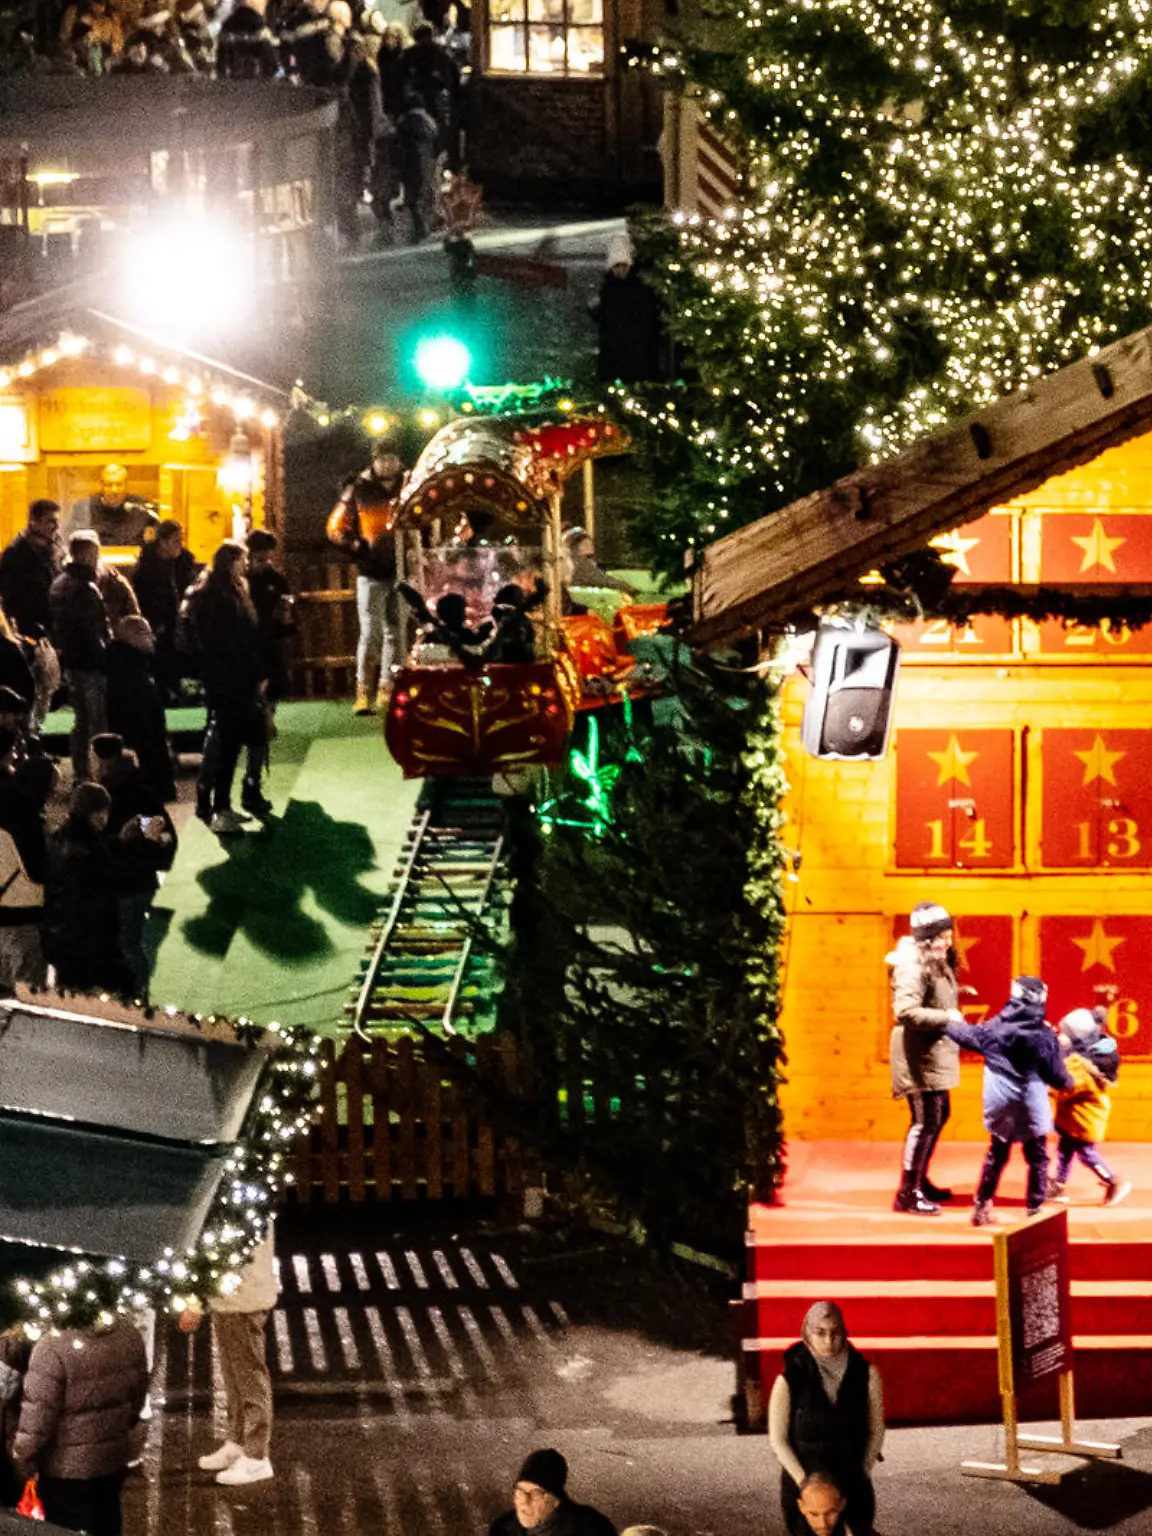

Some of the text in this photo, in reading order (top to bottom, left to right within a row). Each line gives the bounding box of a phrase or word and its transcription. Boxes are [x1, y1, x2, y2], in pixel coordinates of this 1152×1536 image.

[923, 819, 993, 859] 14
[1073, 818, 1141, 858] 13
[1107, 998, 1140, 1038] 6
